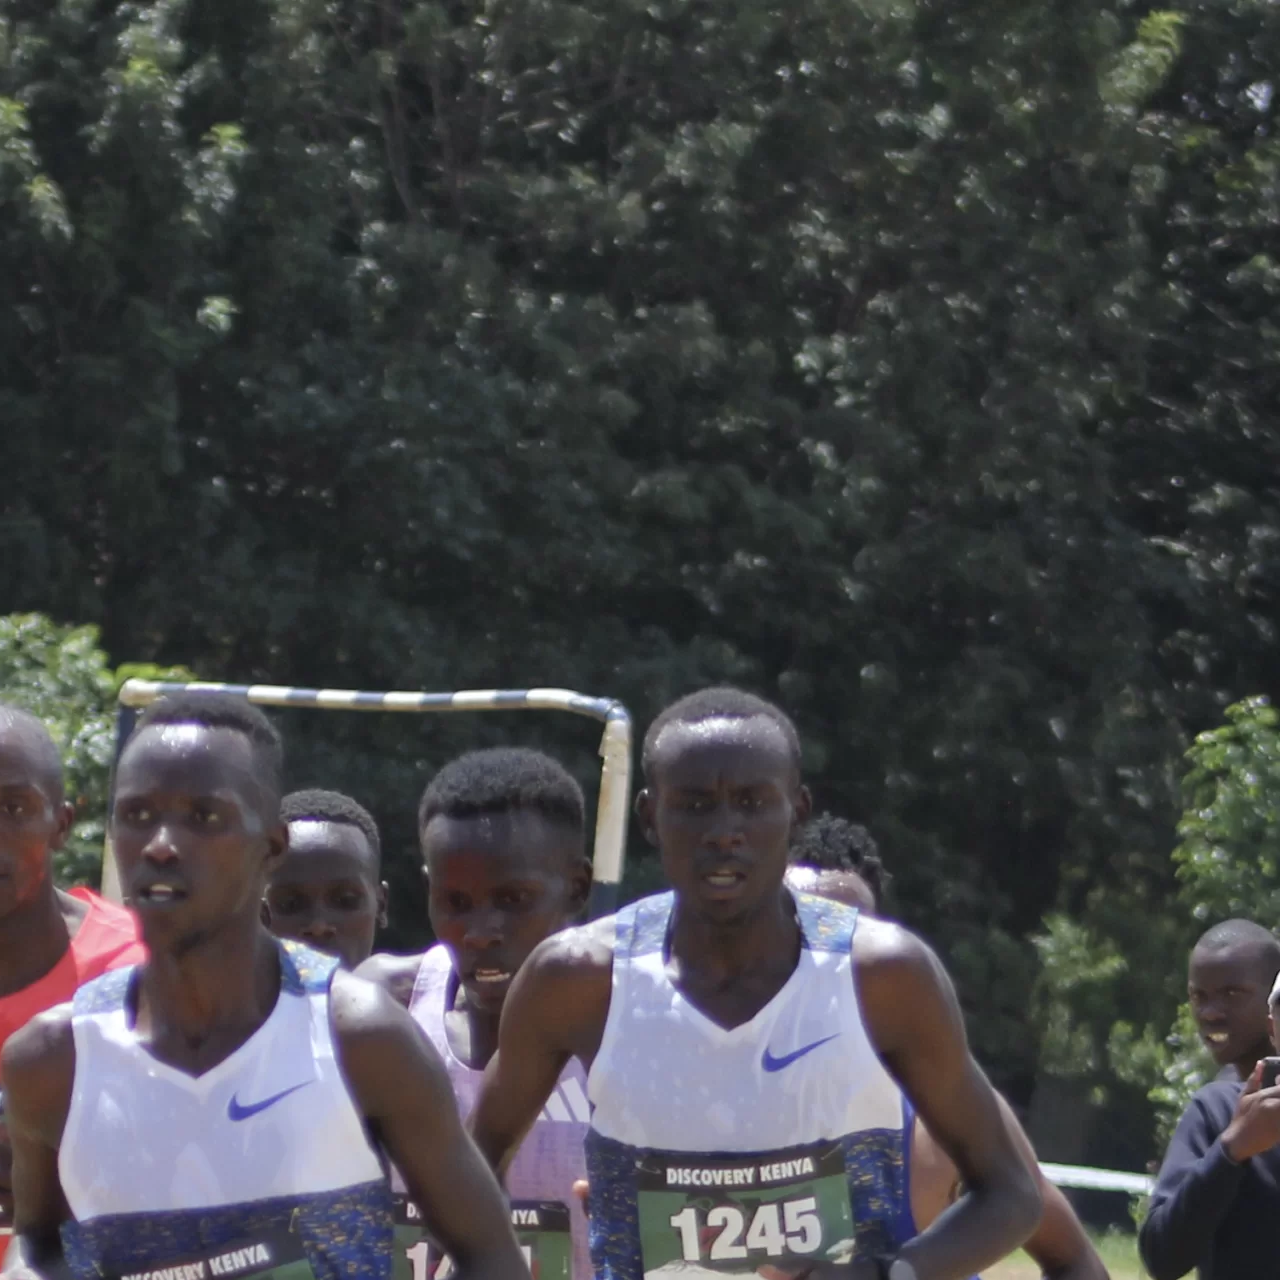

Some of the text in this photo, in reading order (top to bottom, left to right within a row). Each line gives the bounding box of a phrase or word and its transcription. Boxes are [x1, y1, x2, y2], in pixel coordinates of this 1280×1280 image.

[666, 1157, 814, 1186] DISCOVERY KENYA
[670, 1197, 823, 1261] 1245
[209, 1243, 269, 1275] KENYA
